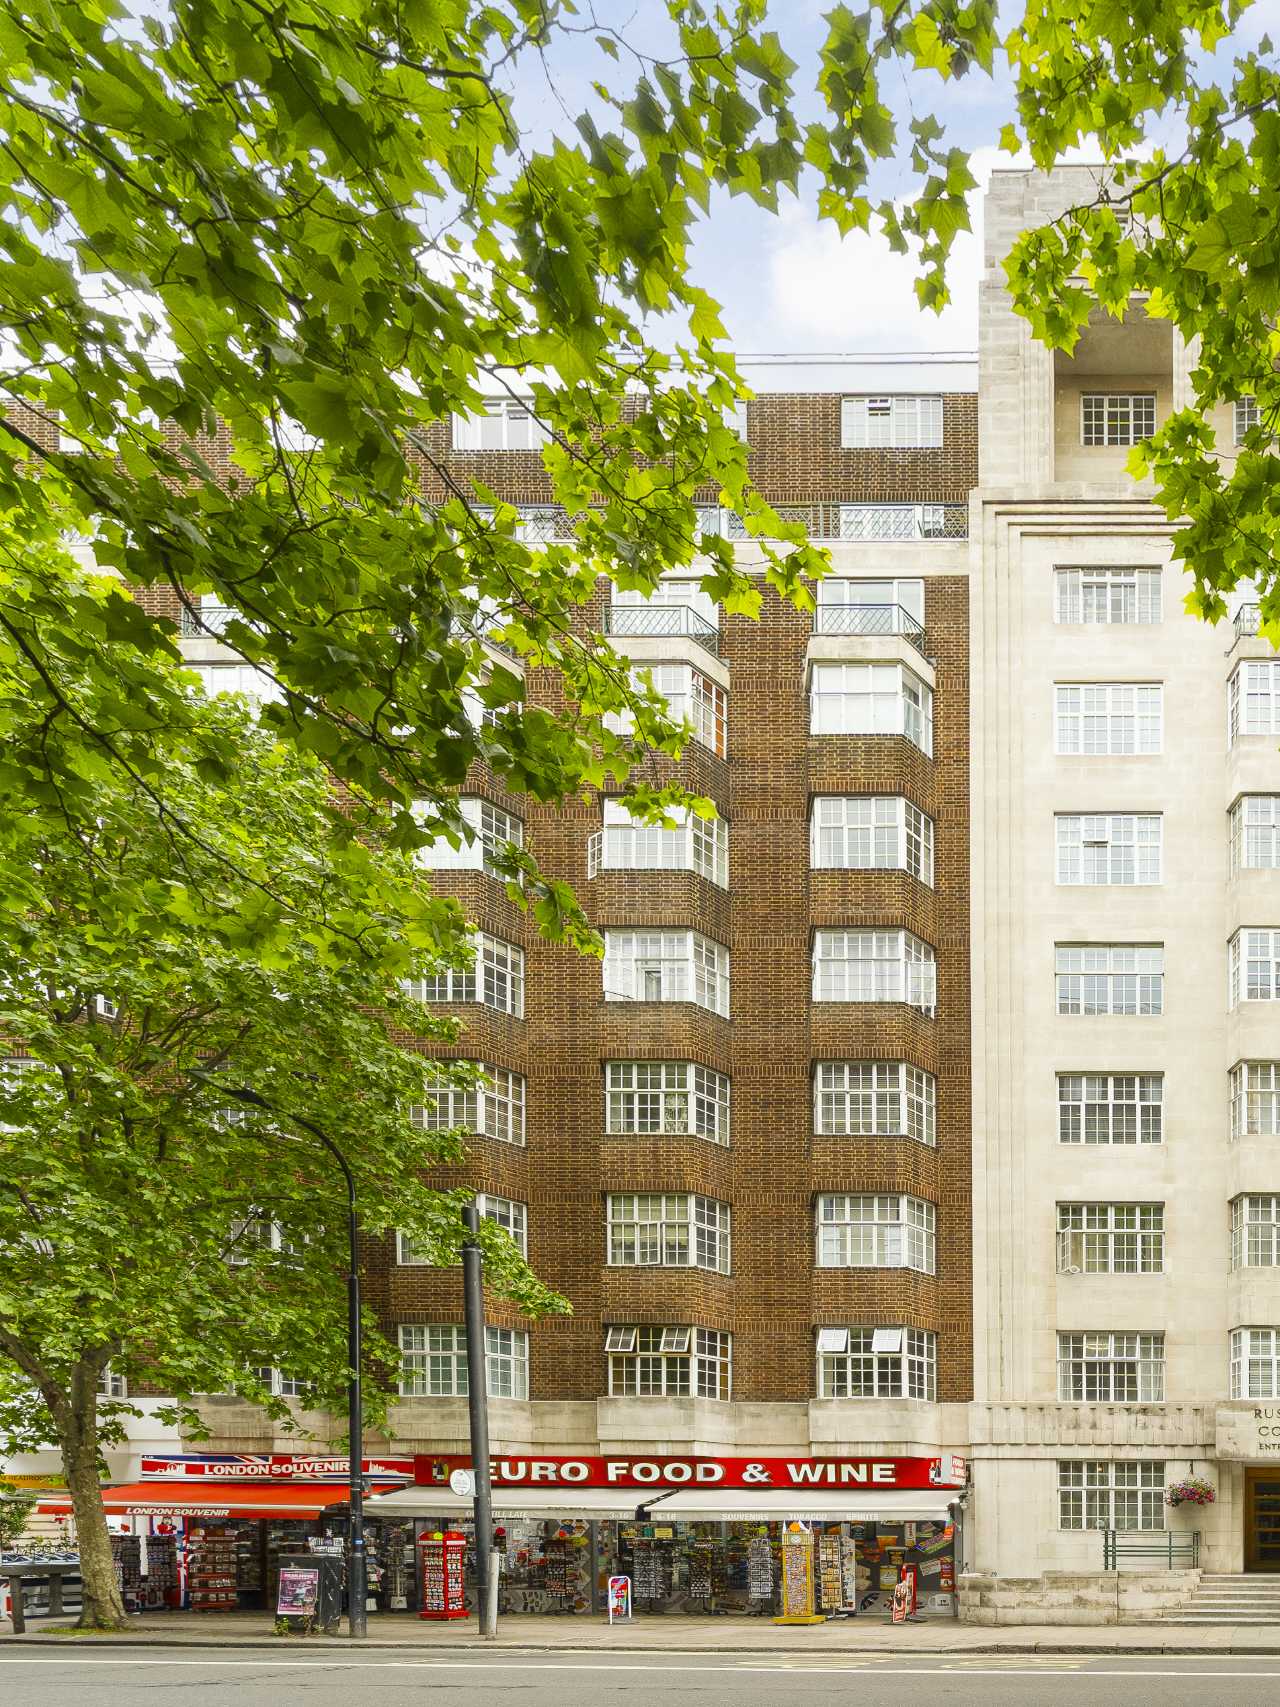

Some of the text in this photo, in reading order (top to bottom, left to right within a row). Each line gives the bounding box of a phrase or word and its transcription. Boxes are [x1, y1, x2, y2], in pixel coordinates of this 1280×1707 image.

[204, 1461, 350, 1476] LONDON SOUVENIR
[607, 1462, 723, 1482] FOOD
[741, 1463, 773, 1483] &
[786, 1463, 897, 1483] WINE
[126, 1507, 230, 1517] LONDON SOUVENIR
[721, 1512, 769, 1520] SOUVENIRS
[788, 1512, 828, 1520] TOBACCO
[846, 1512, 880, 1520] SPIRITS
